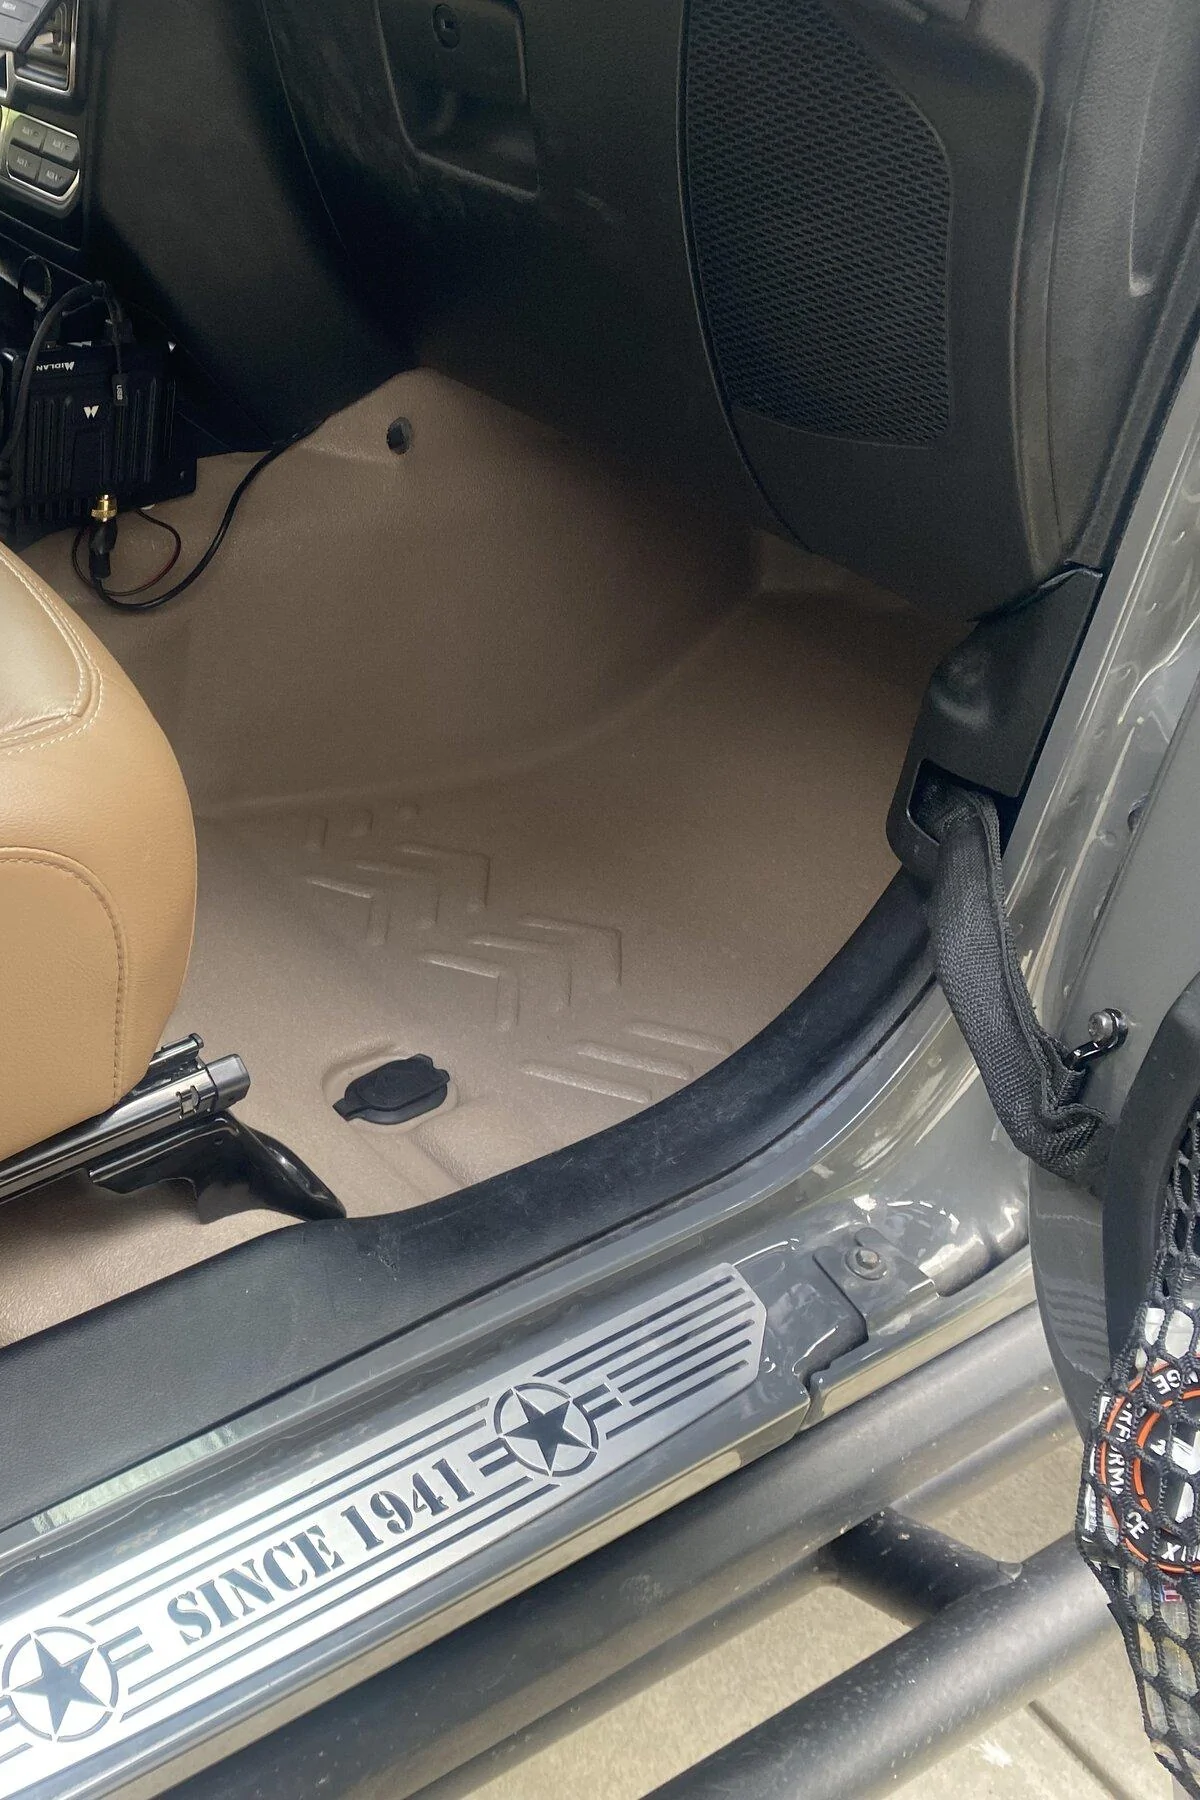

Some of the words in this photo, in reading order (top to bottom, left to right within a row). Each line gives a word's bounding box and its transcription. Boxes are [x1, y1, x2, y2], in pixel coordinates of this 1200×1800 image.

[35, 361, 75, 371] MIDLAN
[166, 1525, 345, 1645] SINCE
[340, 1458, 476, 1550] 1941
